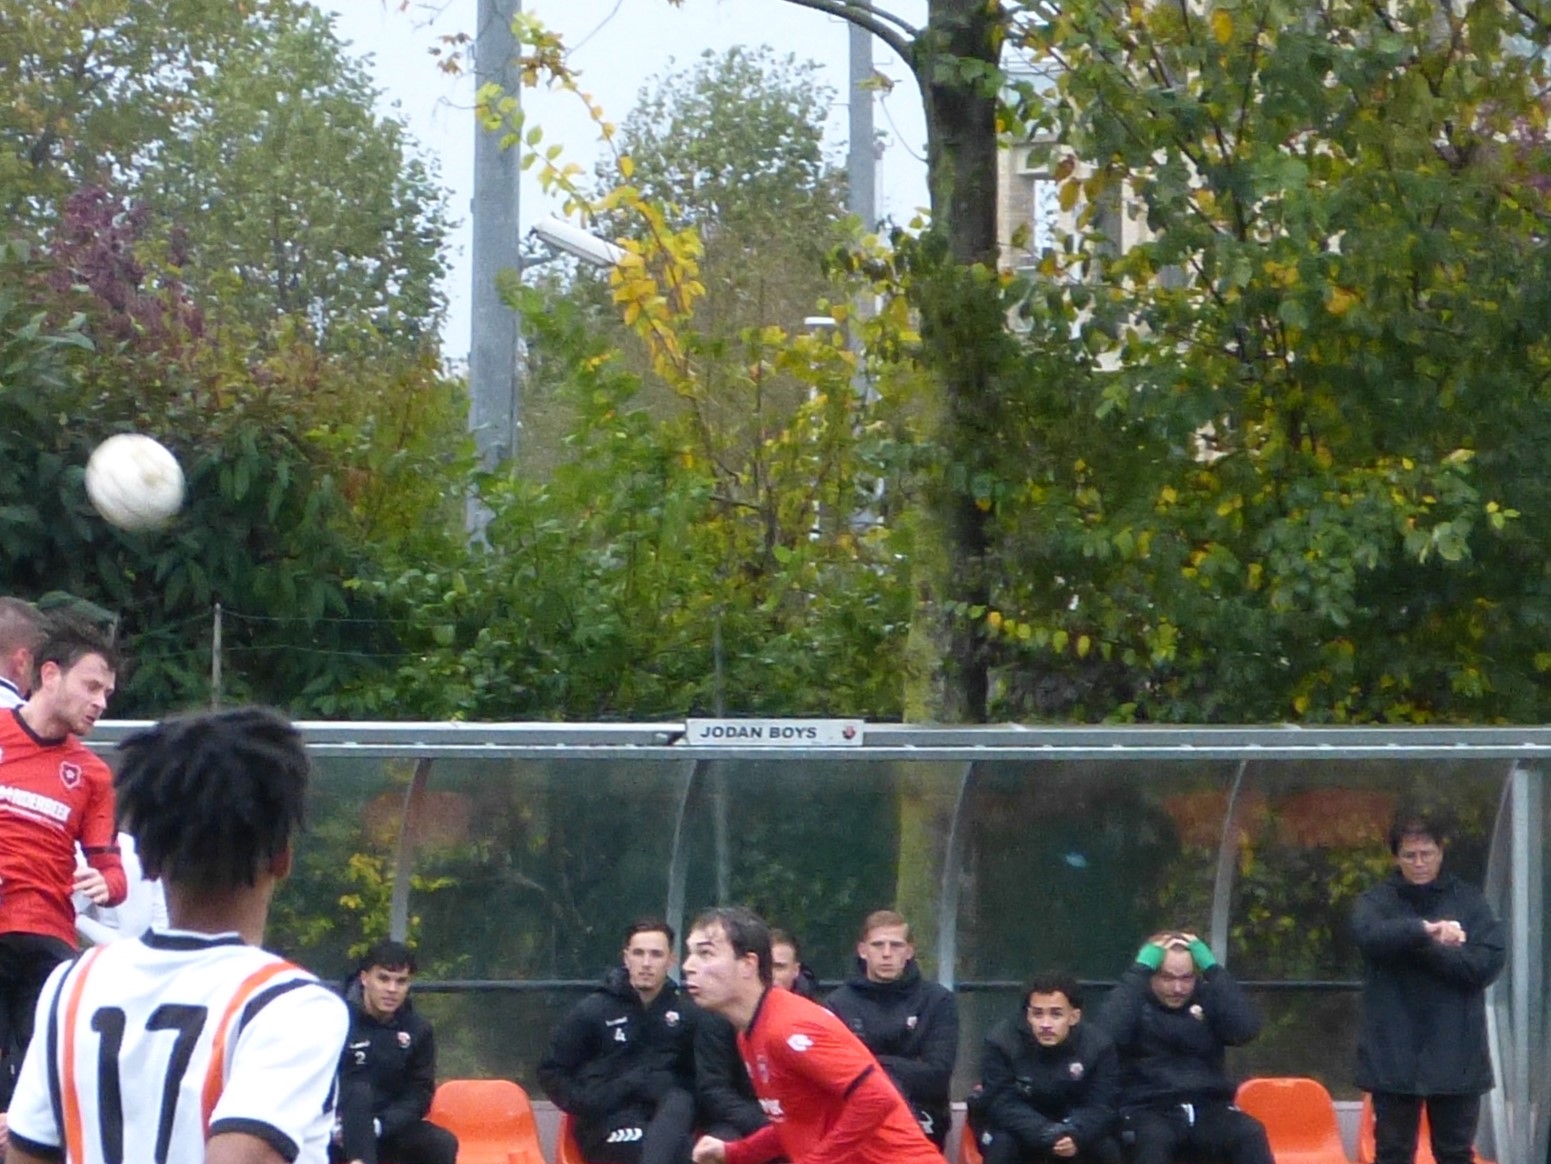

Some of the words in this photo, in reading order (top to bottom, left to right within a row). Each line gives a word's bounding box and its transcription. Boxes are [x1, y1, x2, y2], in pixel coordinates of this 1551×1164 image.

[700, 726, 763, 739] JODAN
[769, 726, 818, 739] BOYS
[354, 1050, 367, 1065] 2
